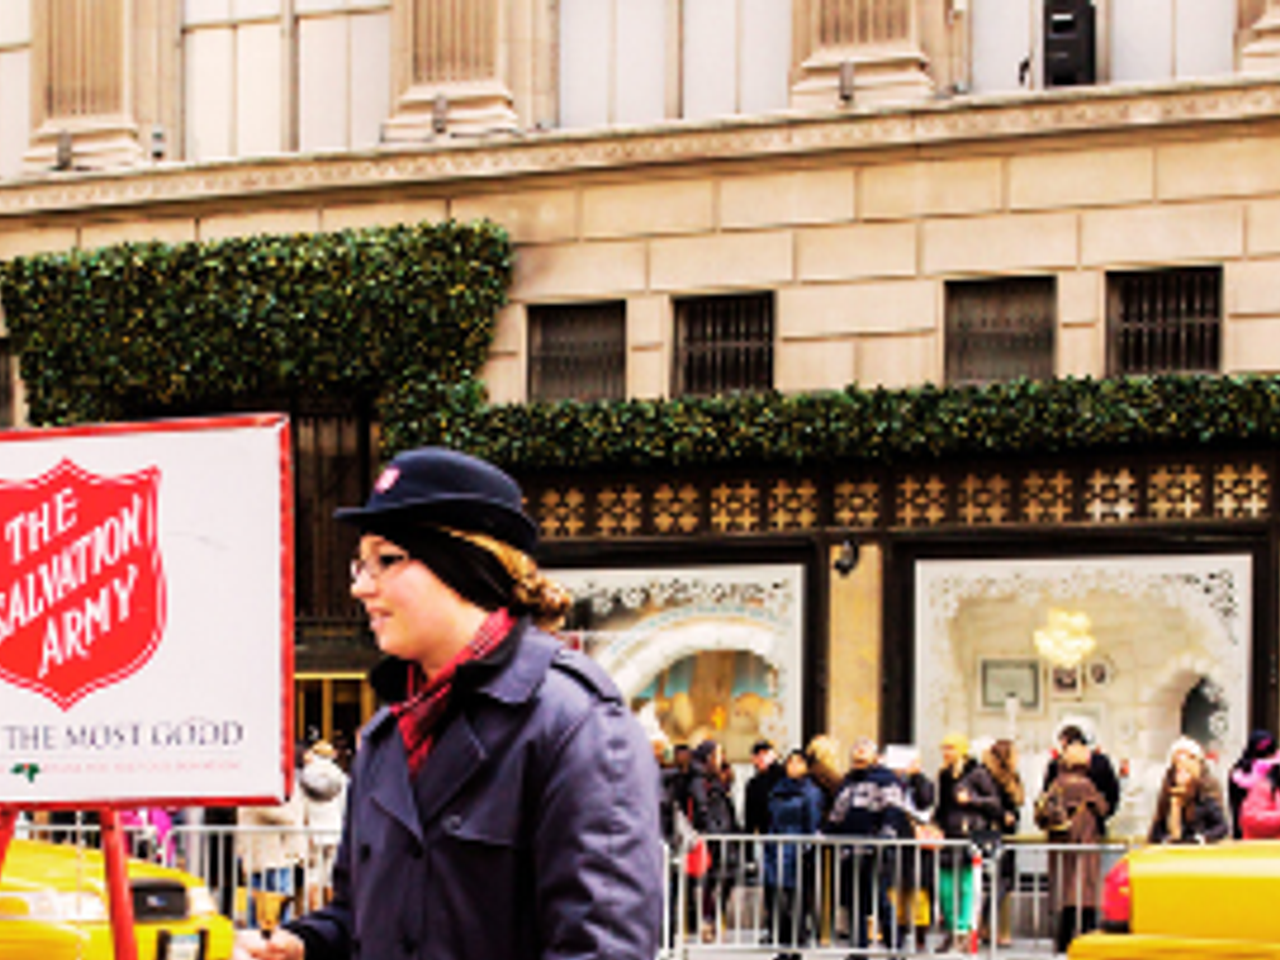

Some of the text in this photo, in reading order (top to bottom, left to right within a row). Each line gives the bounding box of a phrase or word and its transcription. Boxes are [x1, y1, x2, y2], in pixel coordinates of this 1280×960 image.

[4, 487, 79, 565] THE
[36, 562, 140, 679] ARMY
[7, 723, 57, 750] THE
[65, 721, 140, 749] MOST
[150, 719, 244, 748] GOOD
